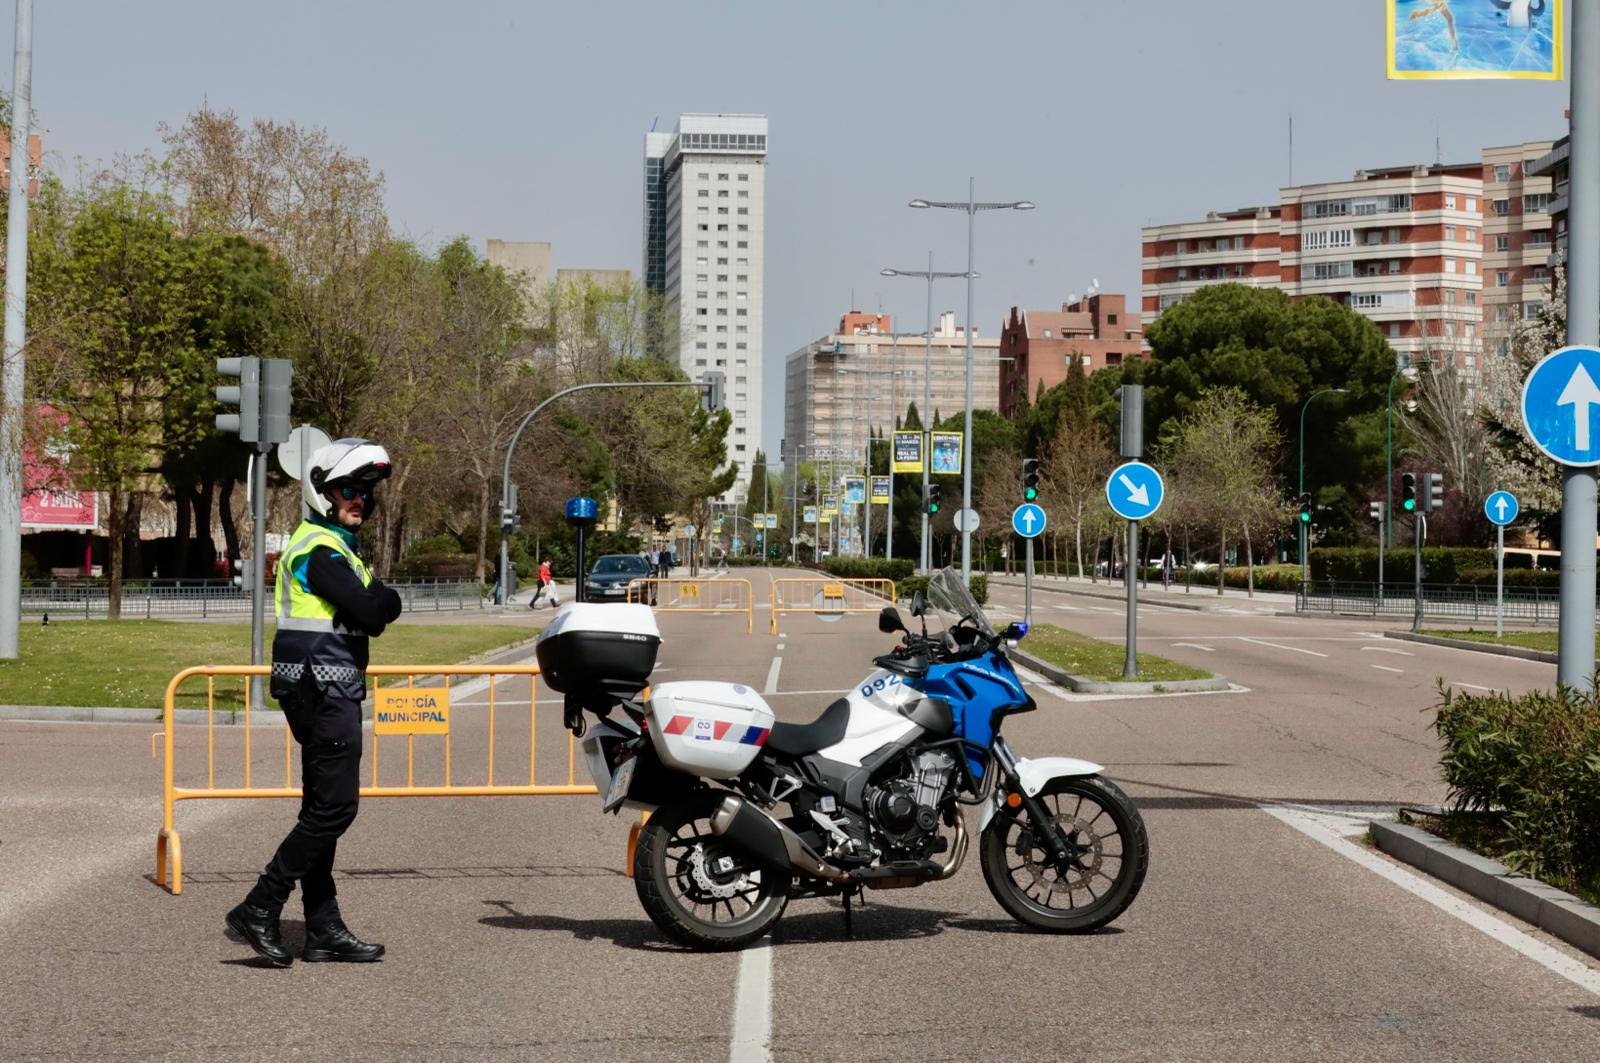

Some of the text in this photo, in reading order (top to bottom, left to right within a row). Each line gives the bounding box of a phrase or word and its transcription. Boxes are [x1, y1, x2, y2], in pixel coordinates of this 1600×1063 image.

[861, 673, 900, 697] 092
[387, 694, 437, 708] POCÍA
[377, 712, 446, 722] MUNICIPAL
